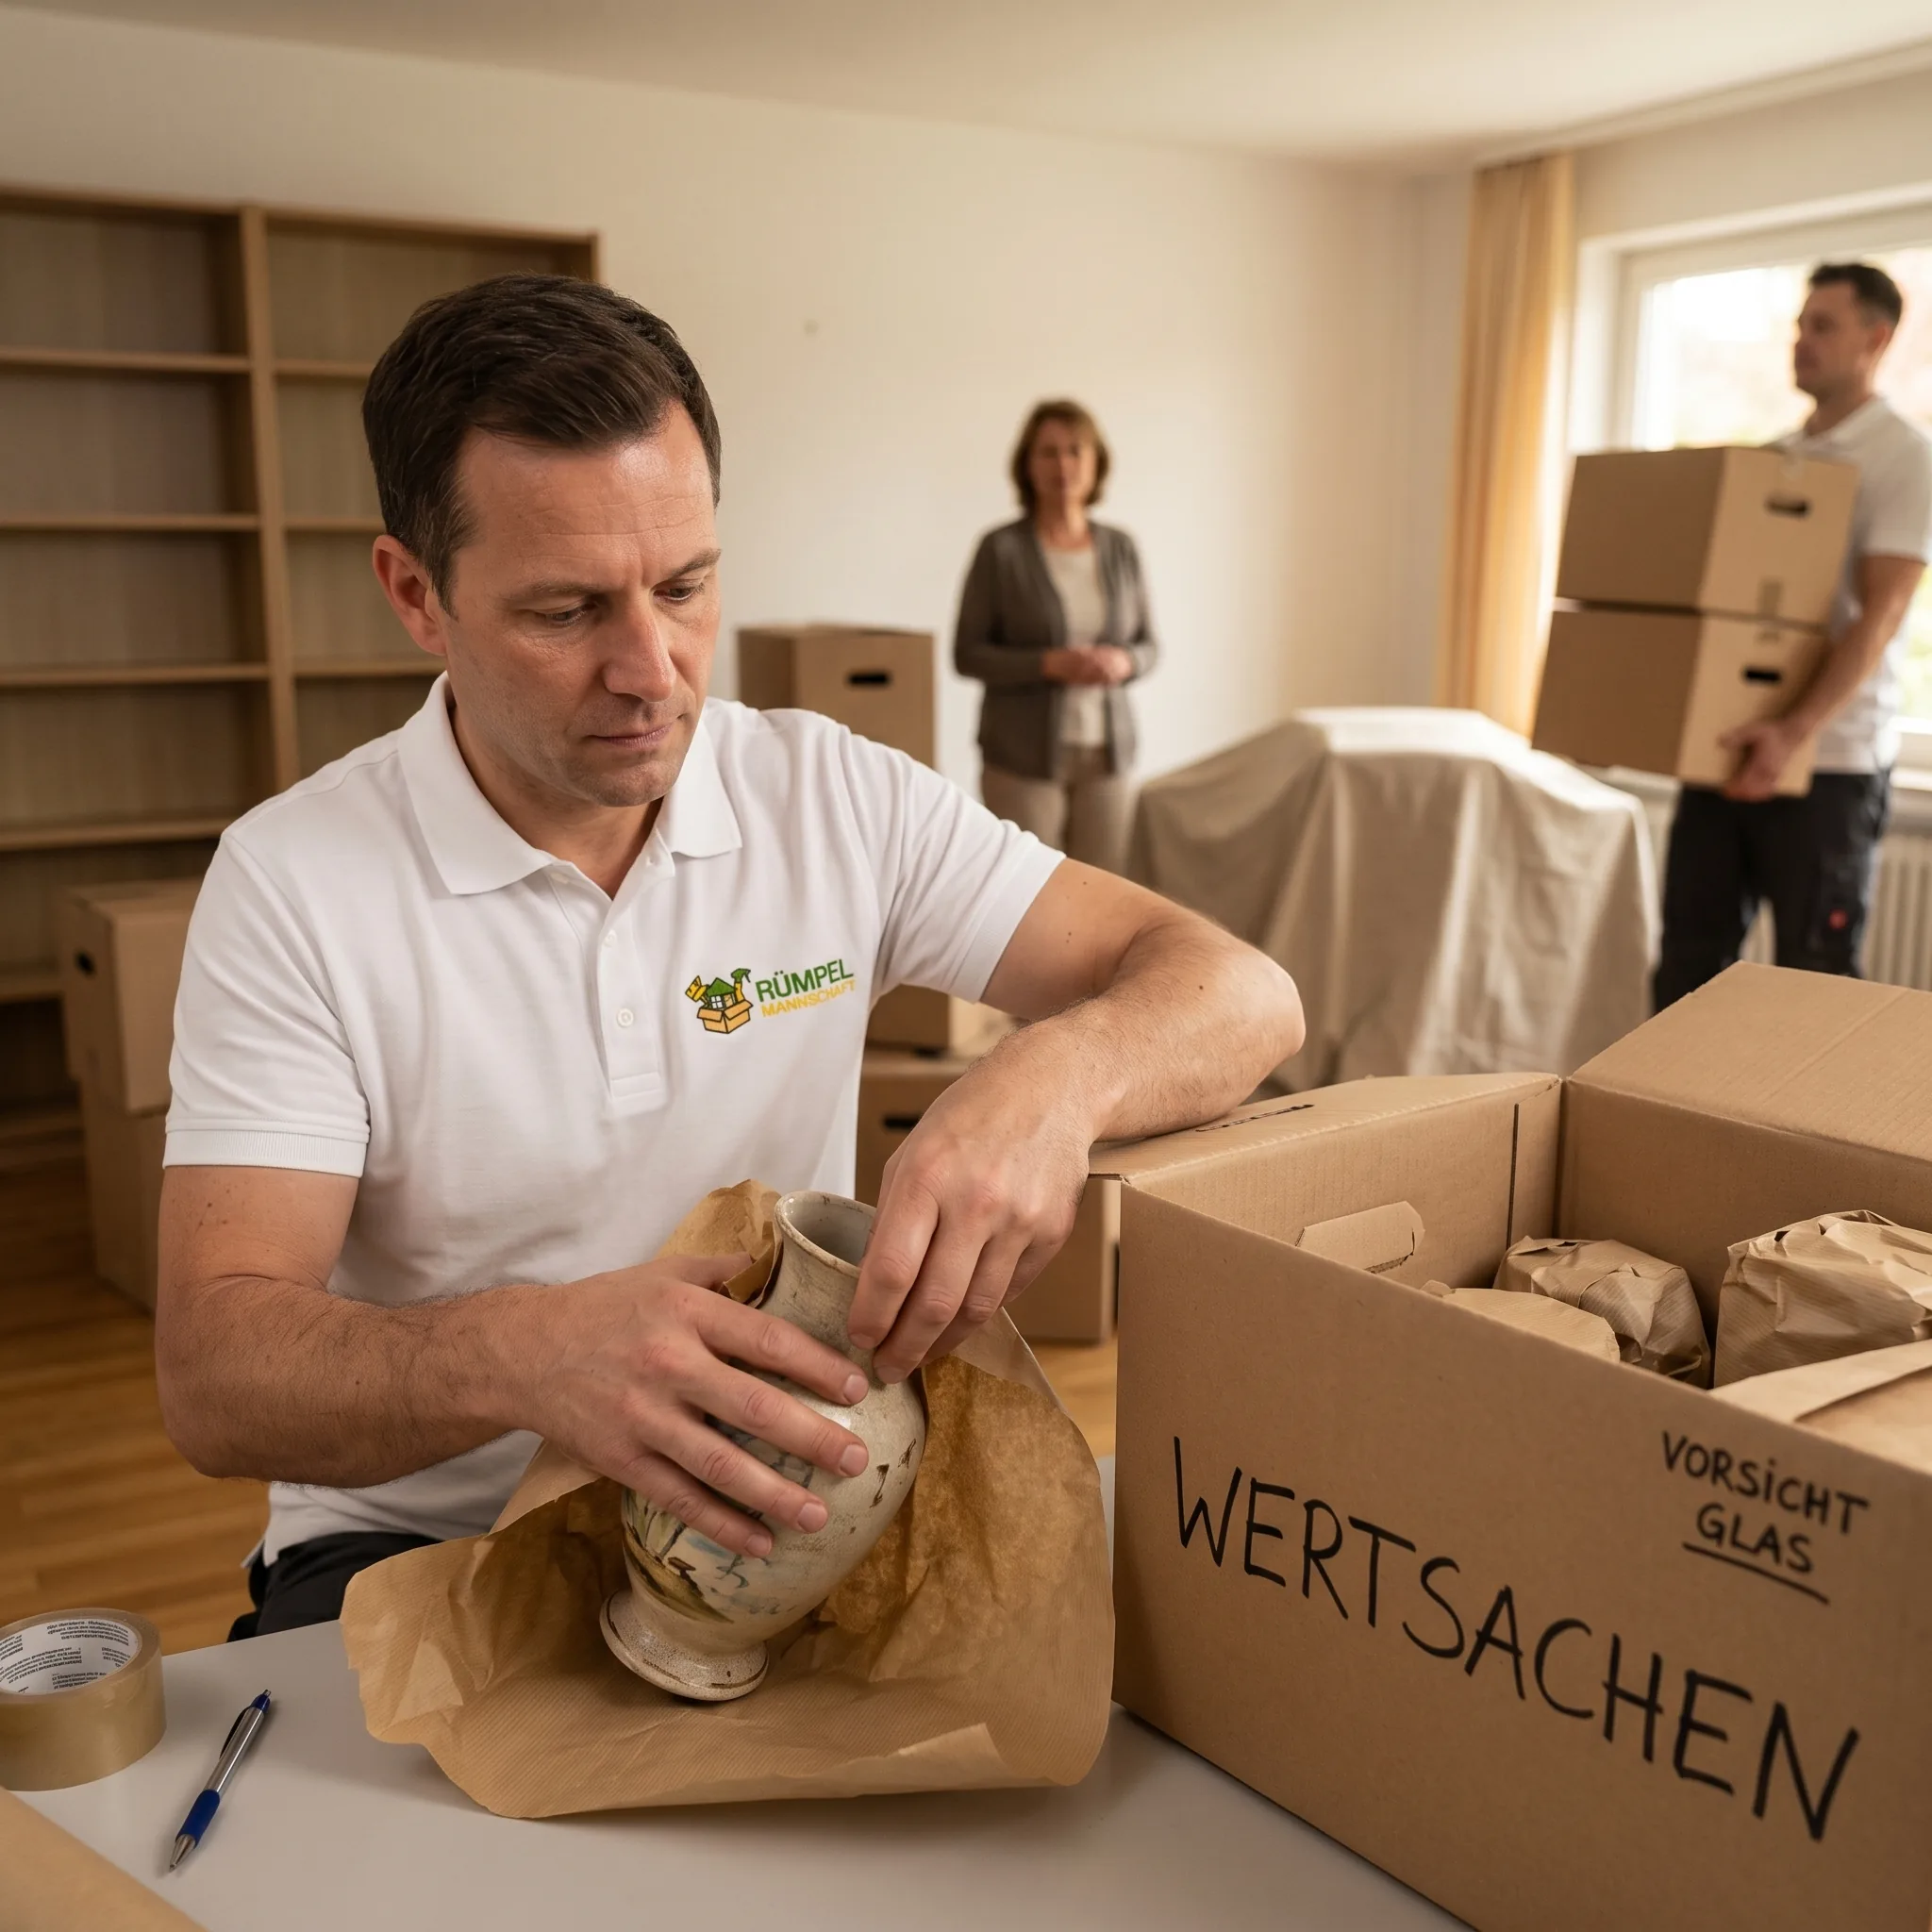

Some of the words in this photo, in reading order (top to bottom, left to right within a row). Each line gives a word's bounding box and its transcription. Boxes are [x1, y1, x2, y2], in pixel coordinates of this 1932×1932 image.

[755, 958, 854, 1002] RÜMPEL
[762, 979, 855, 1017] MANNSCHAFT
[1696, 1502, 1814, 1574] GLAS
[1173, 1436, 1860, 1842] WERTSACHEN
